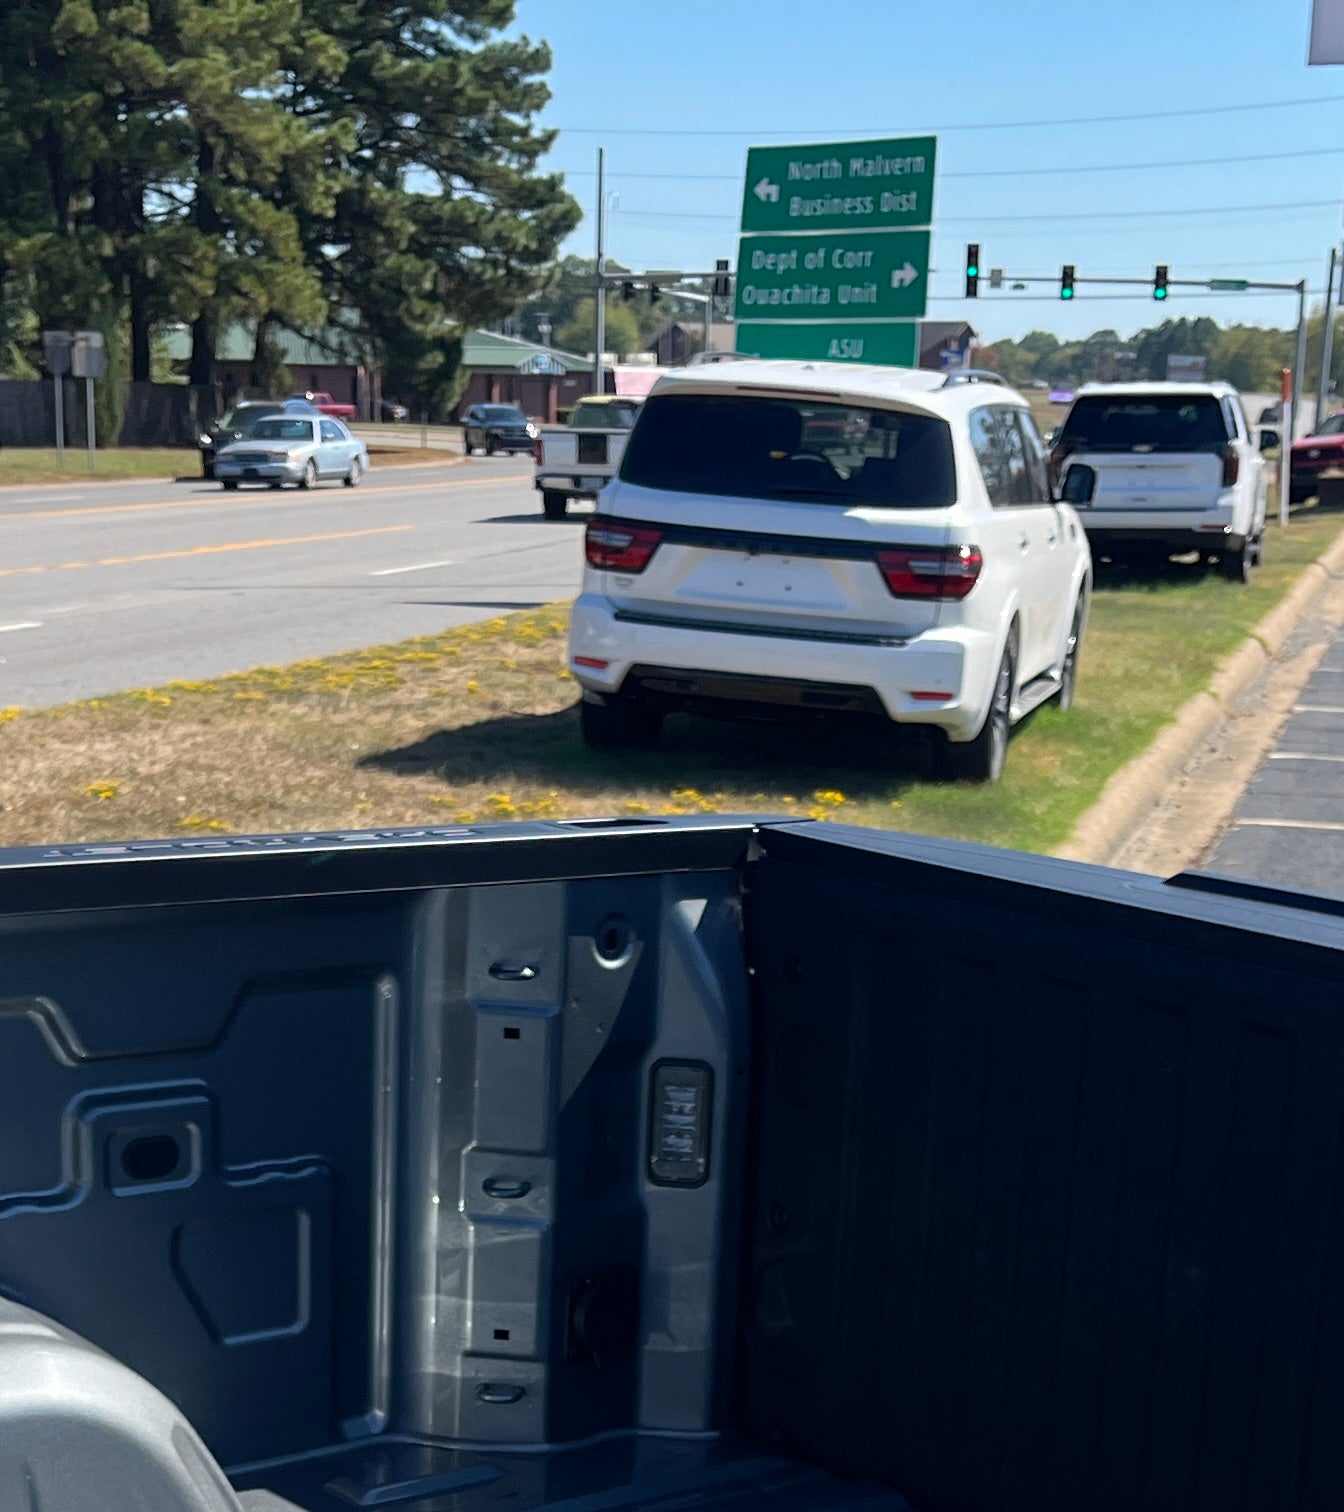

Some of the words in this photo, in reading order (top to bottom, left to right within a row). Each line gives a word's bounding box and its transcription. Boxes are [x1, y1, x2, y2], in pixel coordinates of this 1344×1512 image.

[787, 158, 842, 181] North
[849, 155, 925, 177] Malvern
[789, 194, 874, 217] Business
[880, 190, 918, 213] Dist
[751, 249, 797, 274] Dept
[804, 248, 825, 269] of
[832, 249, 874, 269] Corr
[742, 283, 831, 305] Ouachita
[837, 281, 878, 304] Unit
[827, 339, 864, 358] ASU
